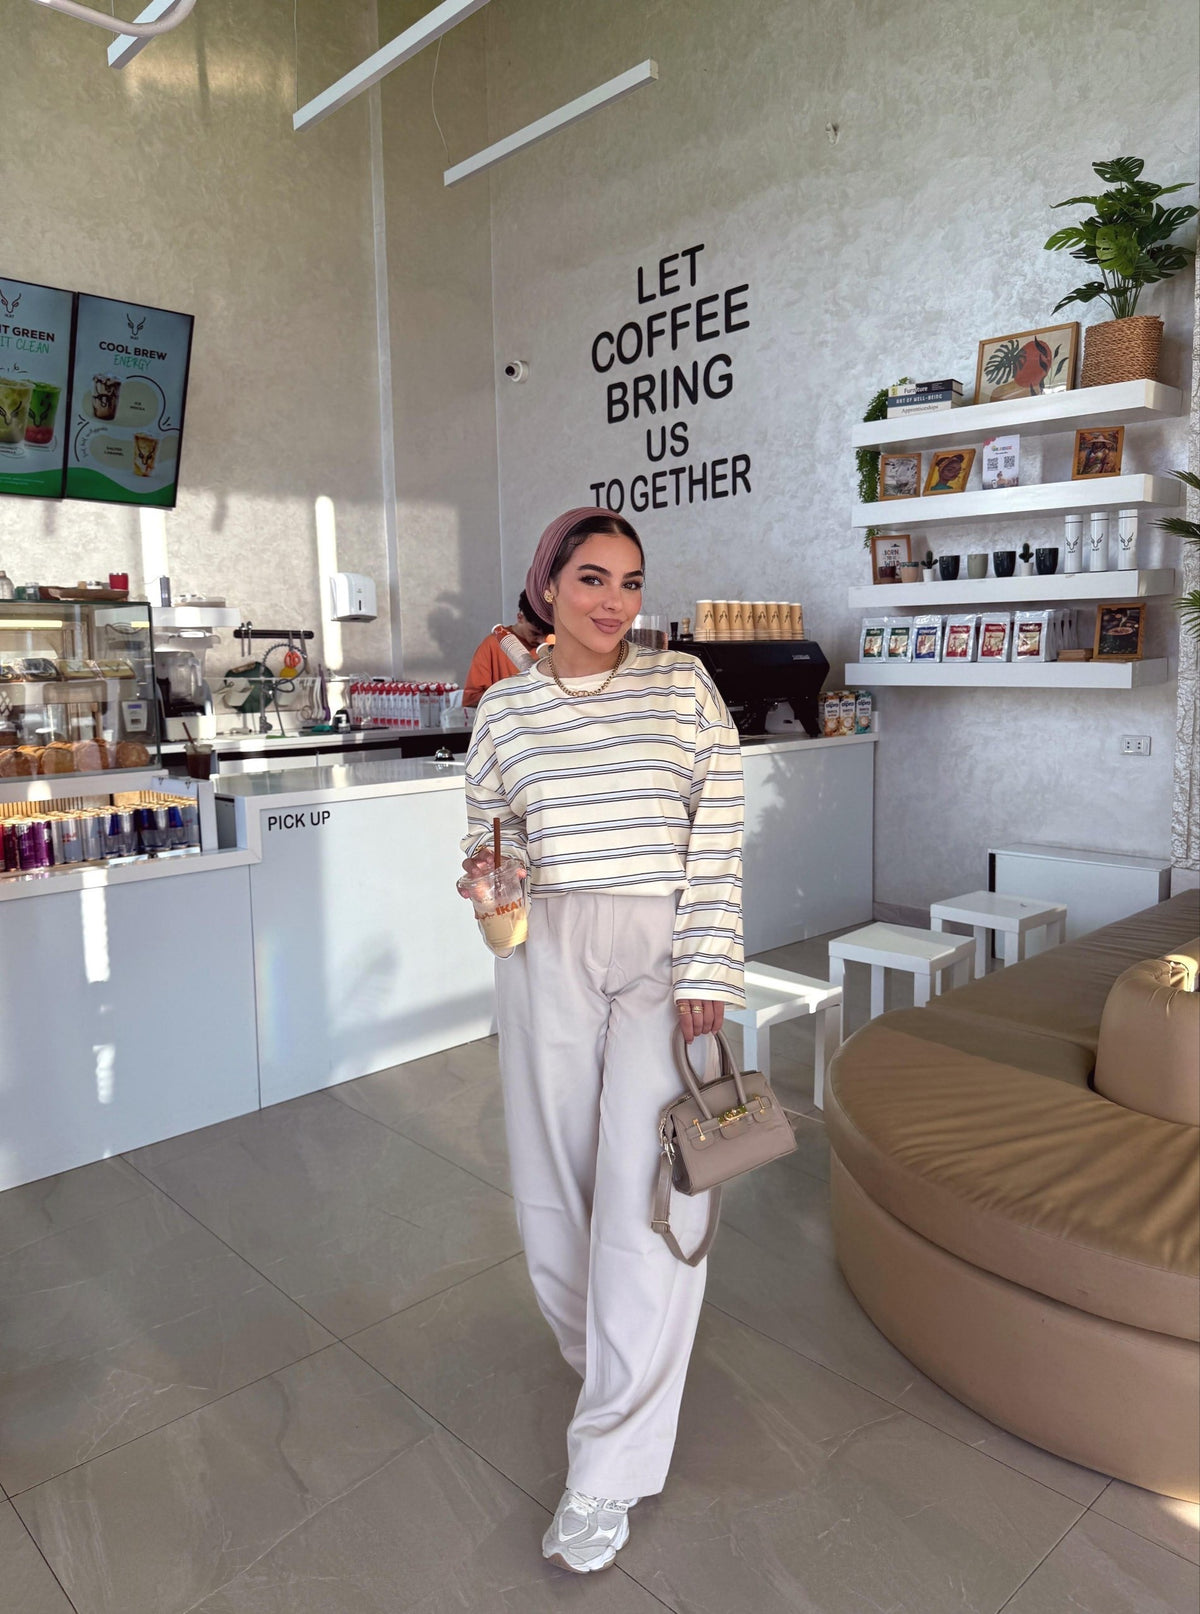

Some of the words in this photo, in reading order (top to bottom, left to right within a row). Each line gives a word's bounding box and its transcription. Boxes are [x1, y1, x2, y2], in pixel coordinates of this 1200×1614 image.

[637, 243, 705, 305] LET
[12, 326, 55, 342] GREEN
[591, 283, 750, 373] COFFEE
[16, 338, 50, 354] CLEAN
[98, 341, 132, 355] COOL
[133, 347, 168, 361] BREW
[113, 354, 152, 372] ENERGY
[607, 353, 733, 424] BRING
[646, 421, 690, 462] US
[590, 453, 752, 513] TOGETHER
[267, 811, 307, 831] PICK
[310, 809, 331, 827] UP
